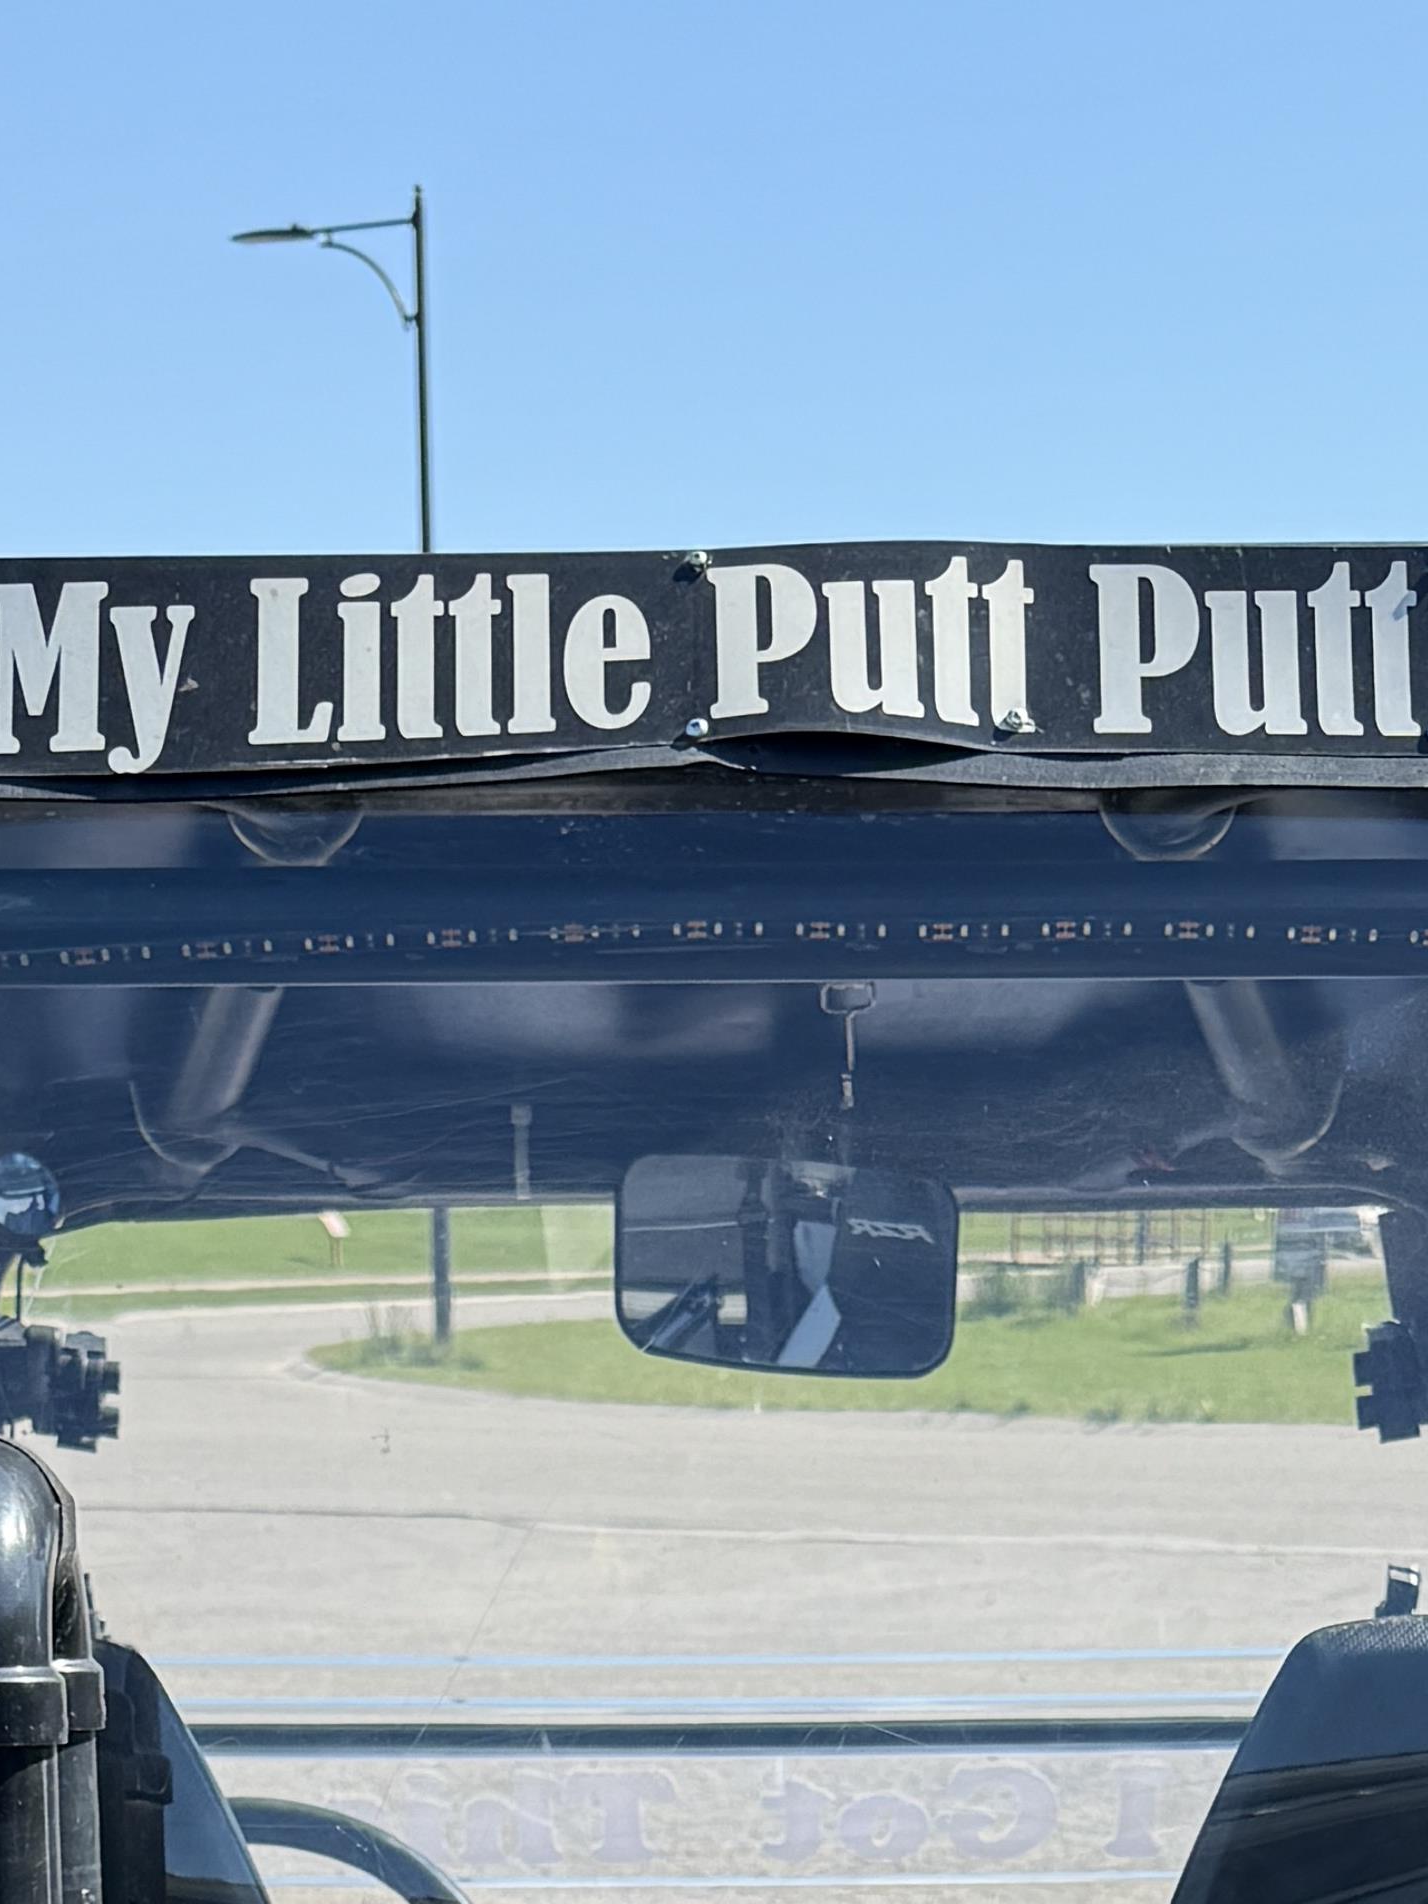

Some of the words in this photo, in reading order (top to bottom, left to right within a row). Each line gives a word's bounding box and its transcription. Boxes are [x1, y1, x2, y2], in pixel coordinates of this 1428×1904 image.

[248, 571, 654, 746] Little
[707, 555, 1035, 733] Putt
[1090, 559, 1419, 738] Putt
